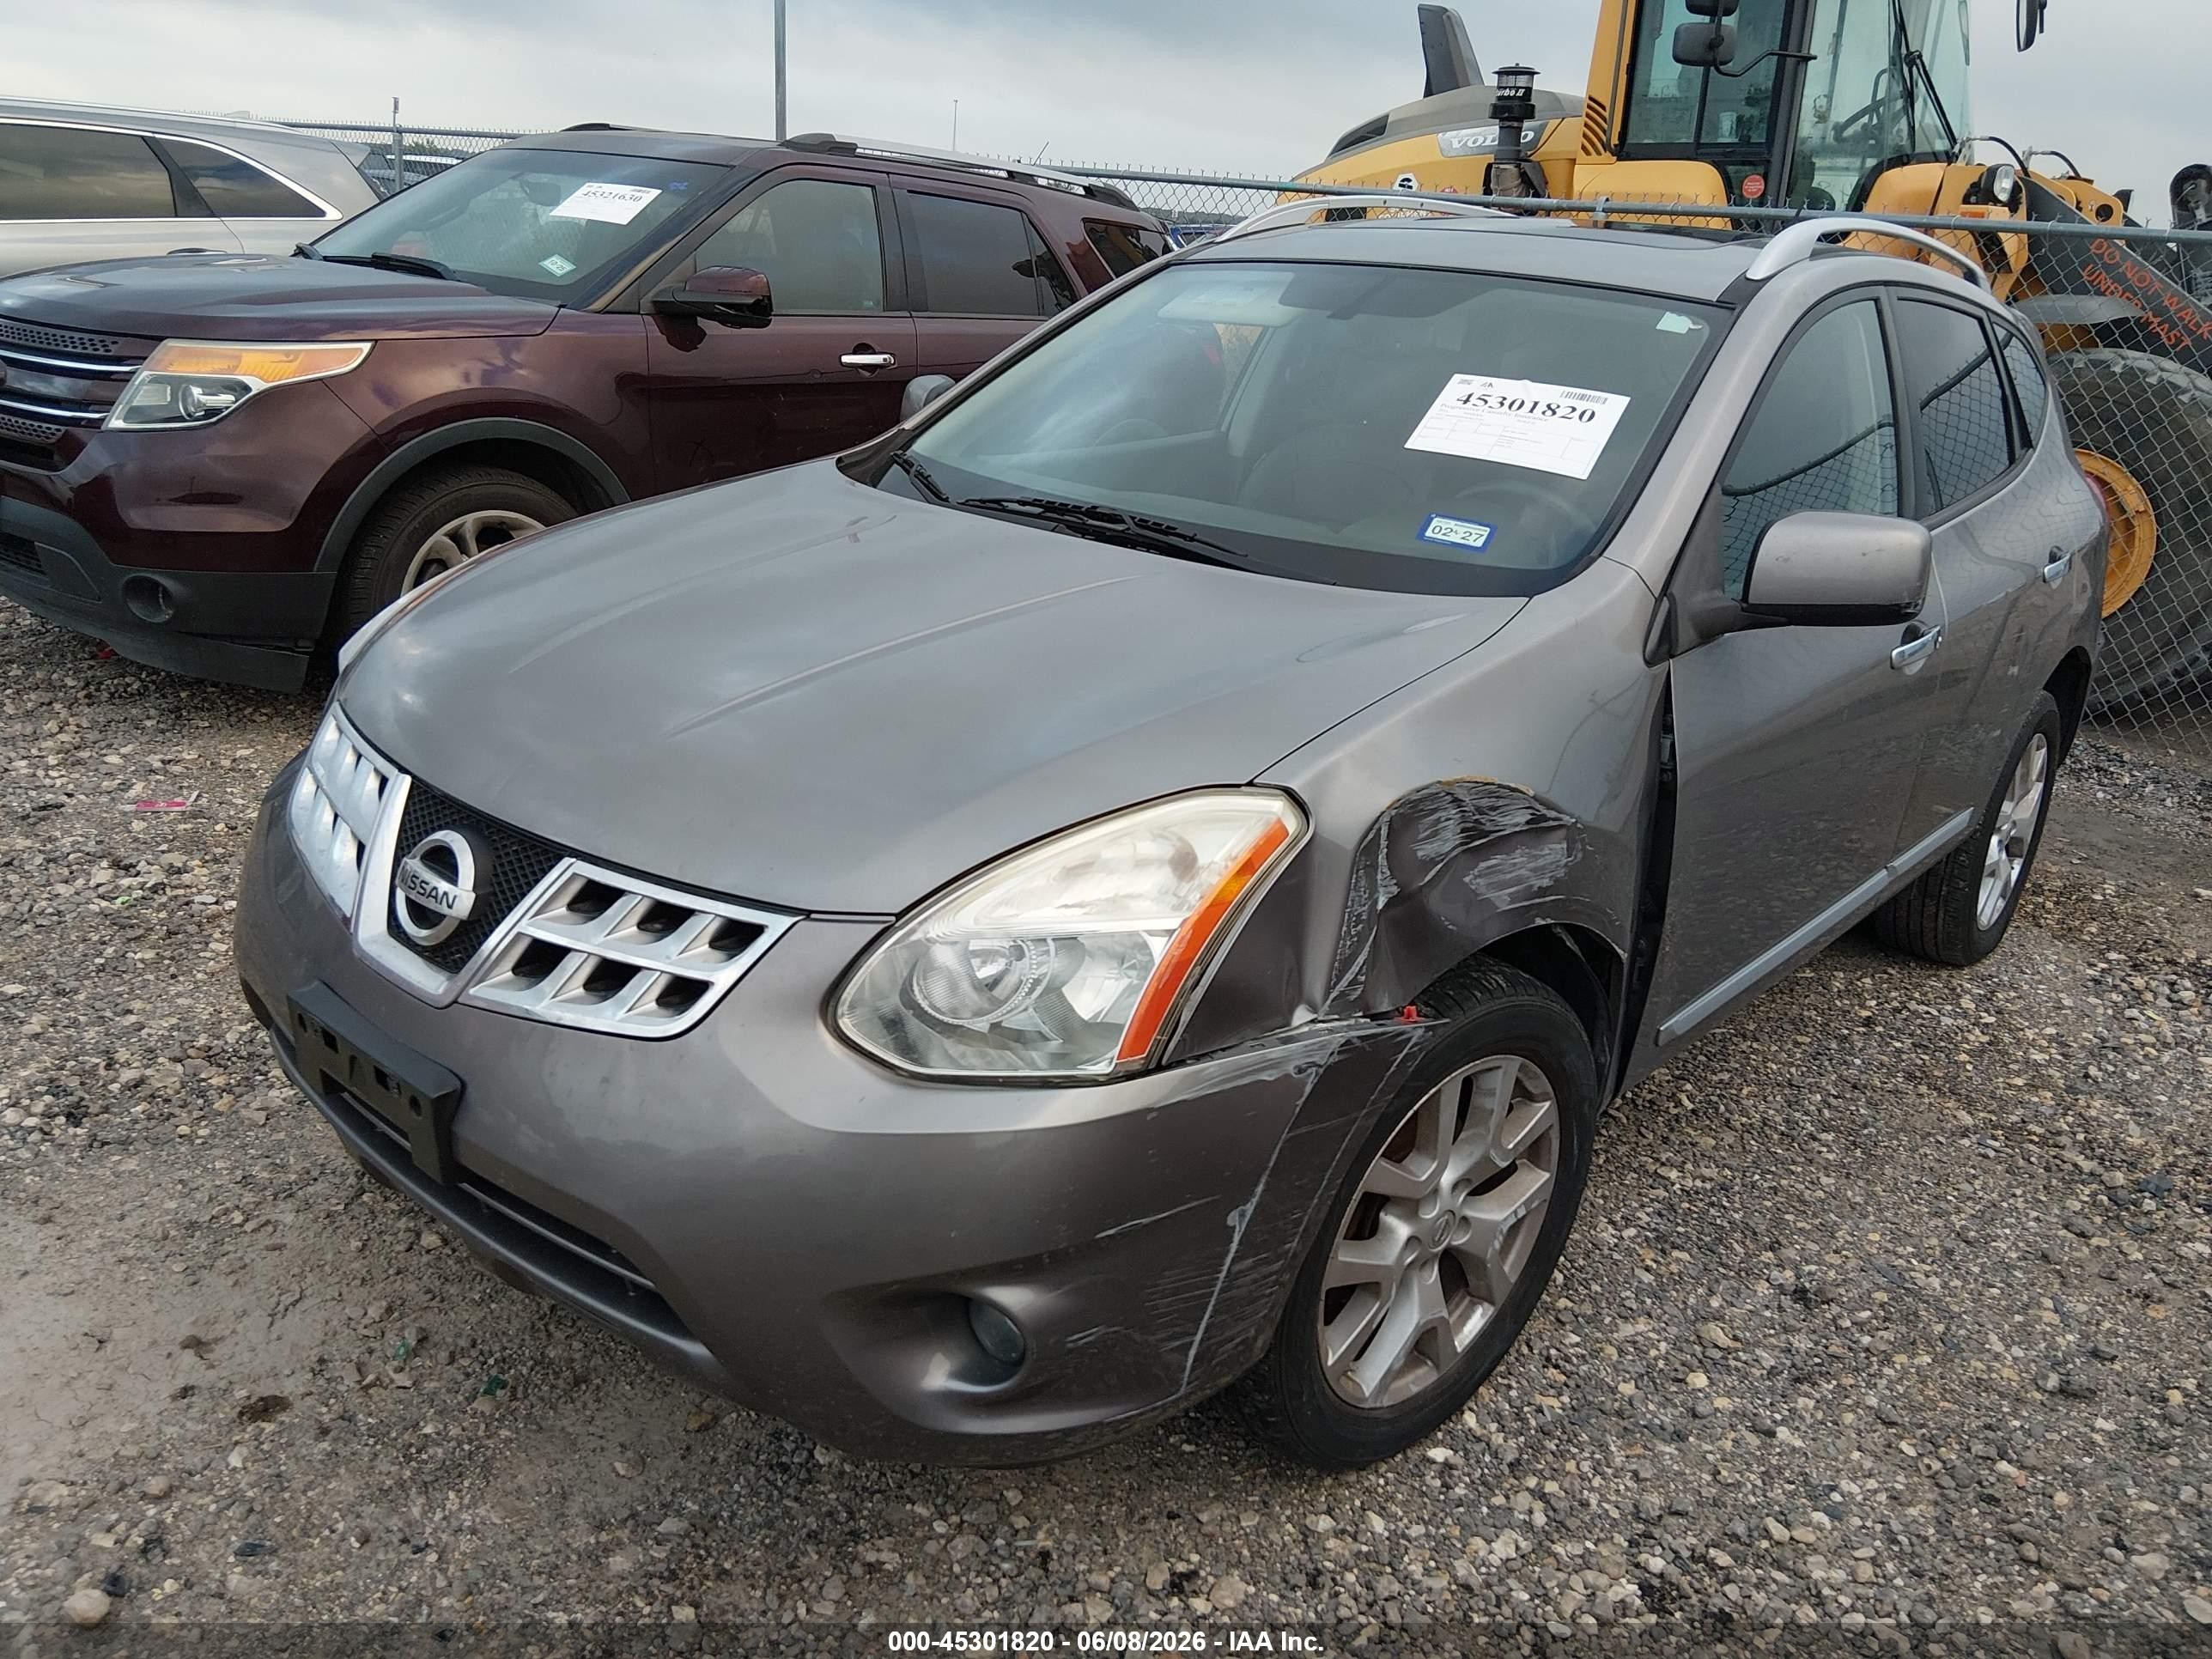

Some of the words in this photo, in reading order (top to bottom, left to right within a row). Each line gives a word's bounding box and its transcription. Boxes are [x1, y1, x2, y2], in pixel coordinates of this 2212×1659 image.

[1450, 131, 1534, 149] VOLO
[581, 190, 643, 203] 45321630
[2088, 238, 2119, 264] DO
[2124, 260, 2163, 295] NOT
[2163, 293, 2212, 339] WALK
[1455, 392, 1596, 424] 45301820
[398, 860, 458, 910] NISSAN
